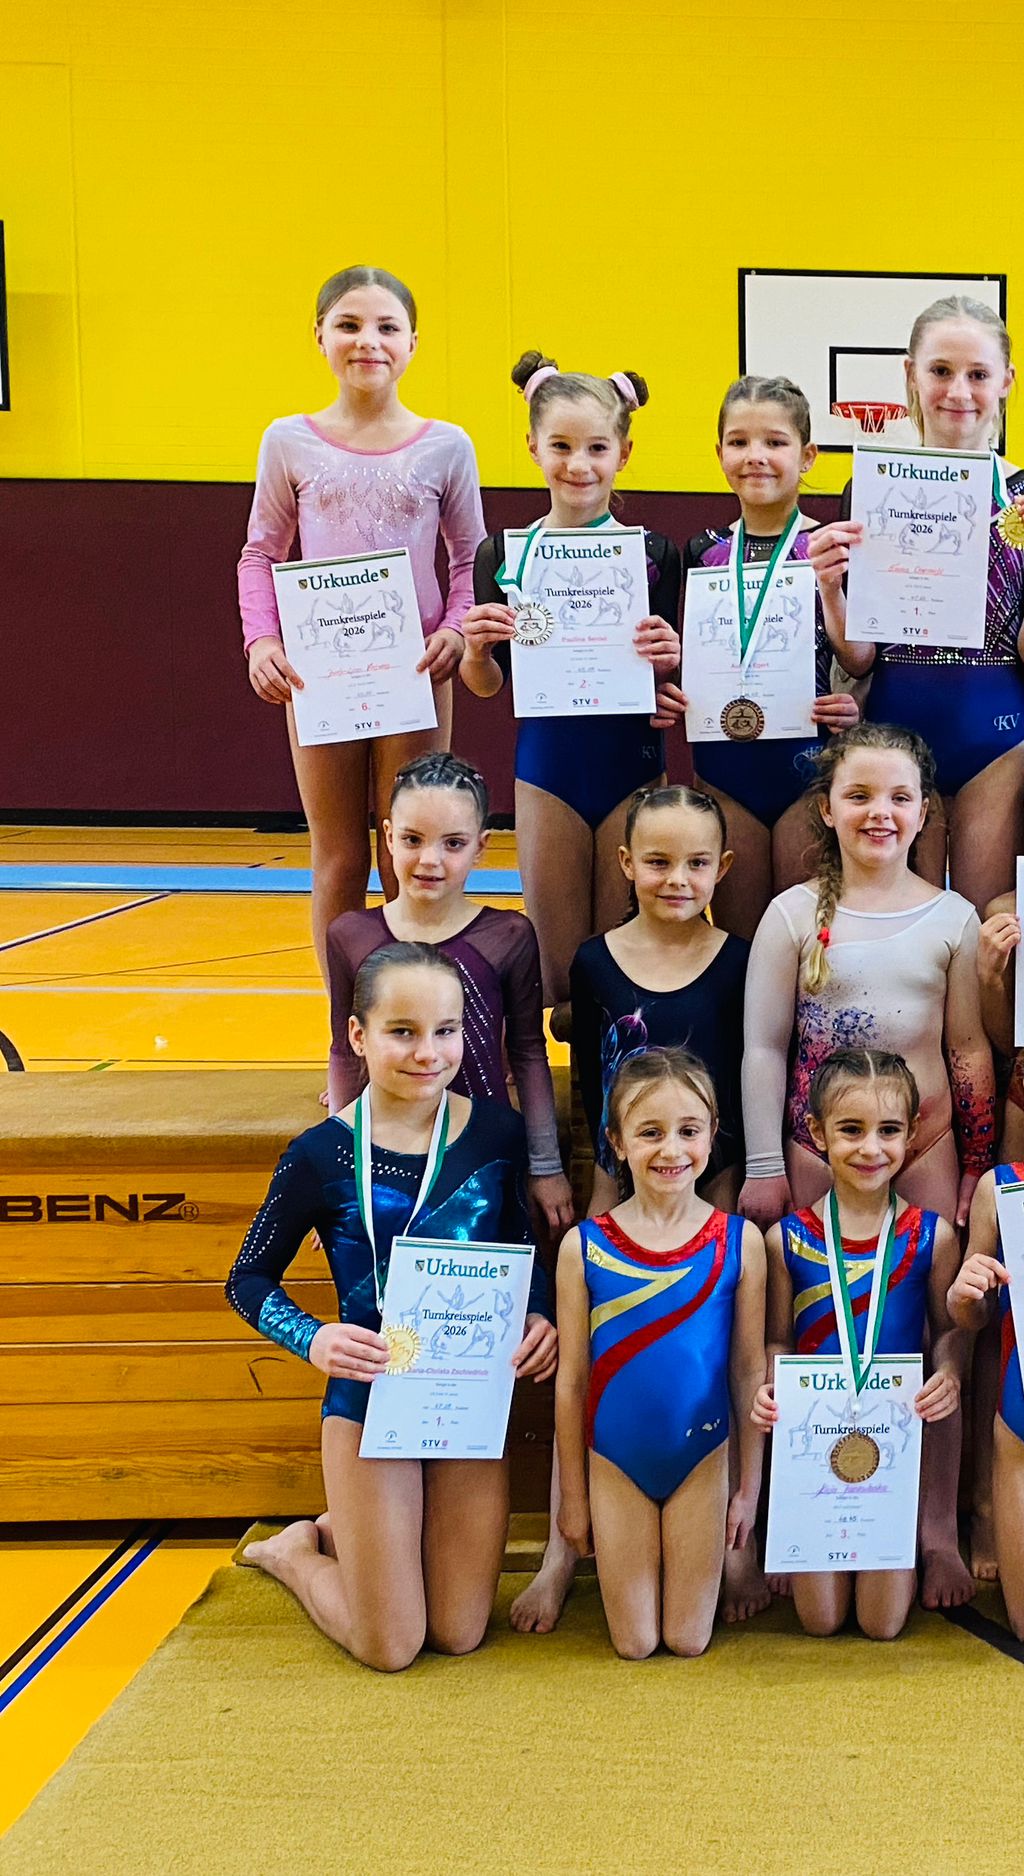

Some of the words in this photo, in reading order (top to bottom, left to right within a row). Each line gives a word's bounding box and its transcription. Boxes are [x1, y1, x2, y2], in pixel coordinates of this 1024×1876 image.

[888, 462, 959, 482] Urkunde
[888, 508, 957, 523] Turnkreisspiele
[911, 523, 933, 534] 2026
[540, 543, 612, 560] Urkunde
[308, 568, 380, 591] Urkunde
[545, 587, 615, 598] Turnkreisspiele
[570, 600, 592, 610] 2026
[317, 610, 386, 628] Turnkreisspiele
[343, 627, 365, 637] 2026
[903, 627, 921, 635] STV
[572, 698, 591, 706] STV
[354, 721, 372, 730] STV
[426, 1258, 498, 1279] Urkunde
[422, 1309, 493, 1324] Turnkreisspiele
[443, 1325, 467, 1336] 2026
[811, 1372, 891, 1391] Urkde
[421, 1439, 441, 1448] STV
[828, 1552, 849, 1560] STV
